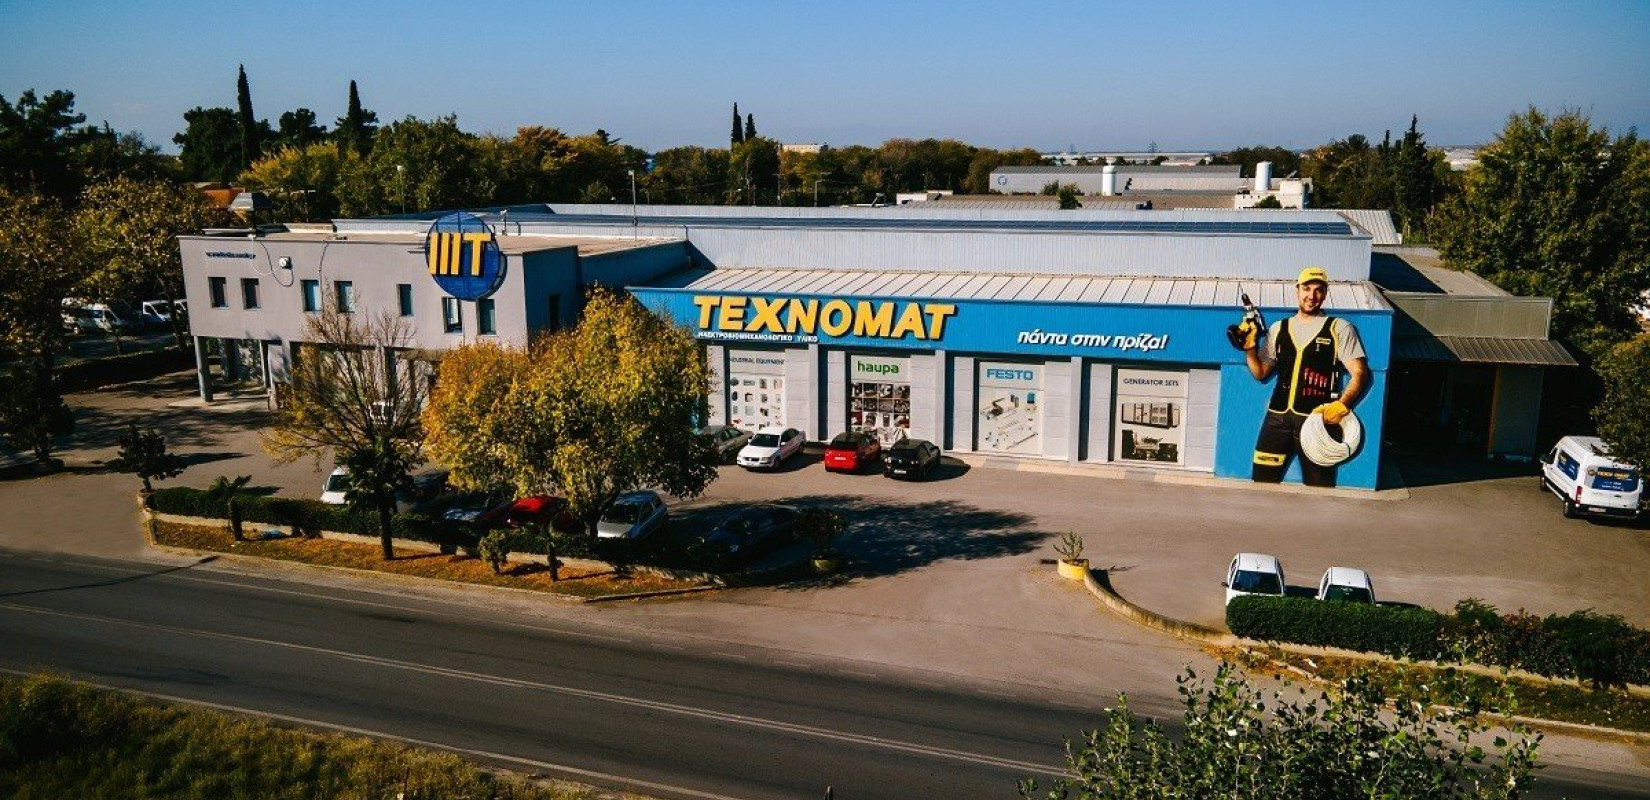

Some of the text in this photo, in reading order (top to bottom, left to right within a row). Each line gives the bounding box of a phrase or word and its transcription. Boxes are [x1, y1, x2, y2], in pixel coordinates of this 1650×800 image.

[1017, 329, 1168, 352] πάντα στην πρίζα!
[857, 361, 900, 376] haupa
[986, 368, 1034, 381] FESTO
[1123, 378, 1179, 387] GENERATOR SETS
